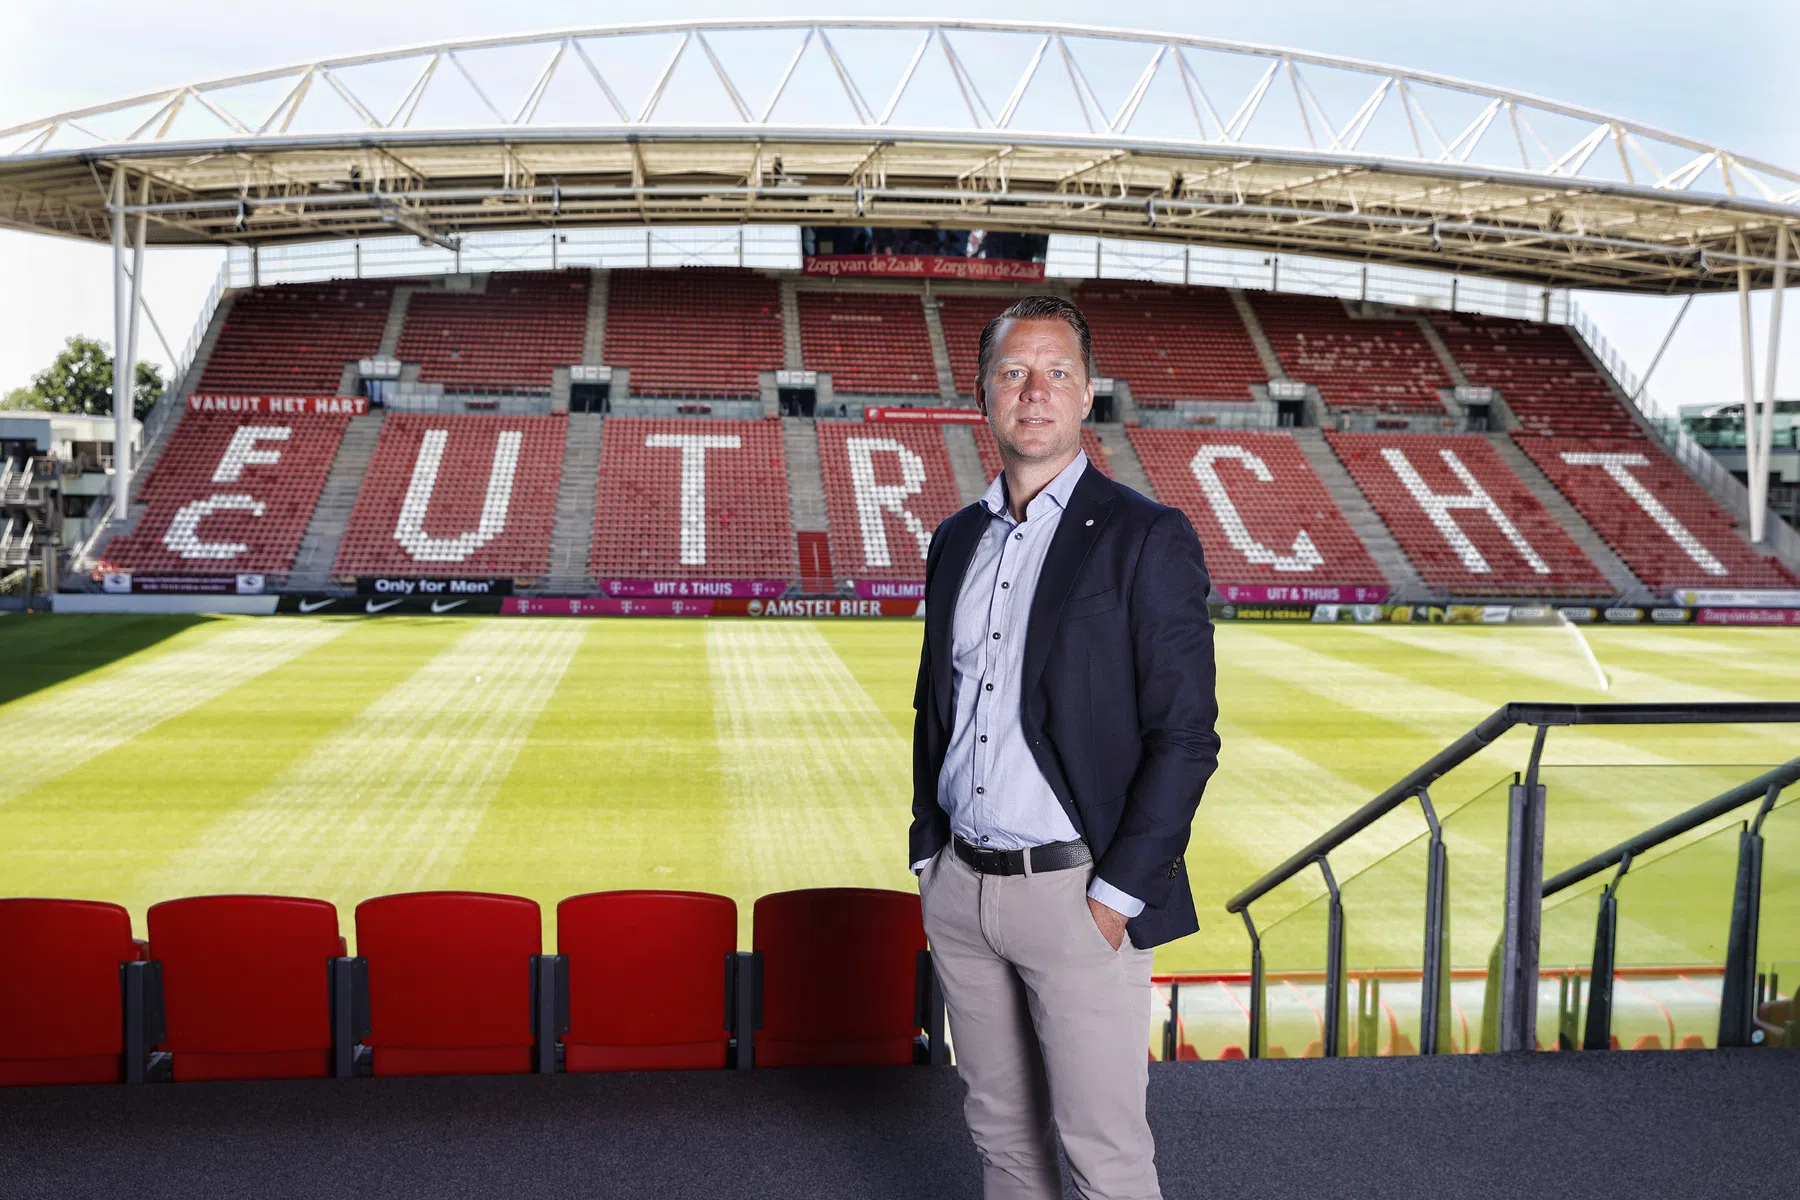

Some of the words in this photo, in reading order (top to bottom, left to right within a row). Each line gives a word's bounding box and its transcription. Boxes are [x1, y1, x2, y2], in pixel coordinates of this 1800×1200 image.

[807, 257, 839, 275] Zorg
[840, 260, 867, 272] van
[868, 258, 886, 272] de
[887, 257, 924, 273] Zaak
[934, 258, 966, 277] Zorg
[967, 262, 992, 276] van
[994, 261, 1010, 276] de
[1011, 262, 1041, 279] Zaak
[190, 396, 261, 411] VANUIT
[270, 398, 307, 412] HET
[315, 399, 366, 414] HART
[375, 579, 415, 594] Only
[419, 579, 446, 592] for
[450, 580, 488, 593] Men
[653, 582, 677, 594] UIT
[679, 582, 689, 594] &
[691, 583, 733, 595] THUIS
[1267, 588, 1288, 600] UIT
[1290, 588, 1300, 600] &
[1301, 588, 1340, 600] THUIS
[765, 600, 835, 616] AMSTEL
[840, 601, 882, 616] BIER
